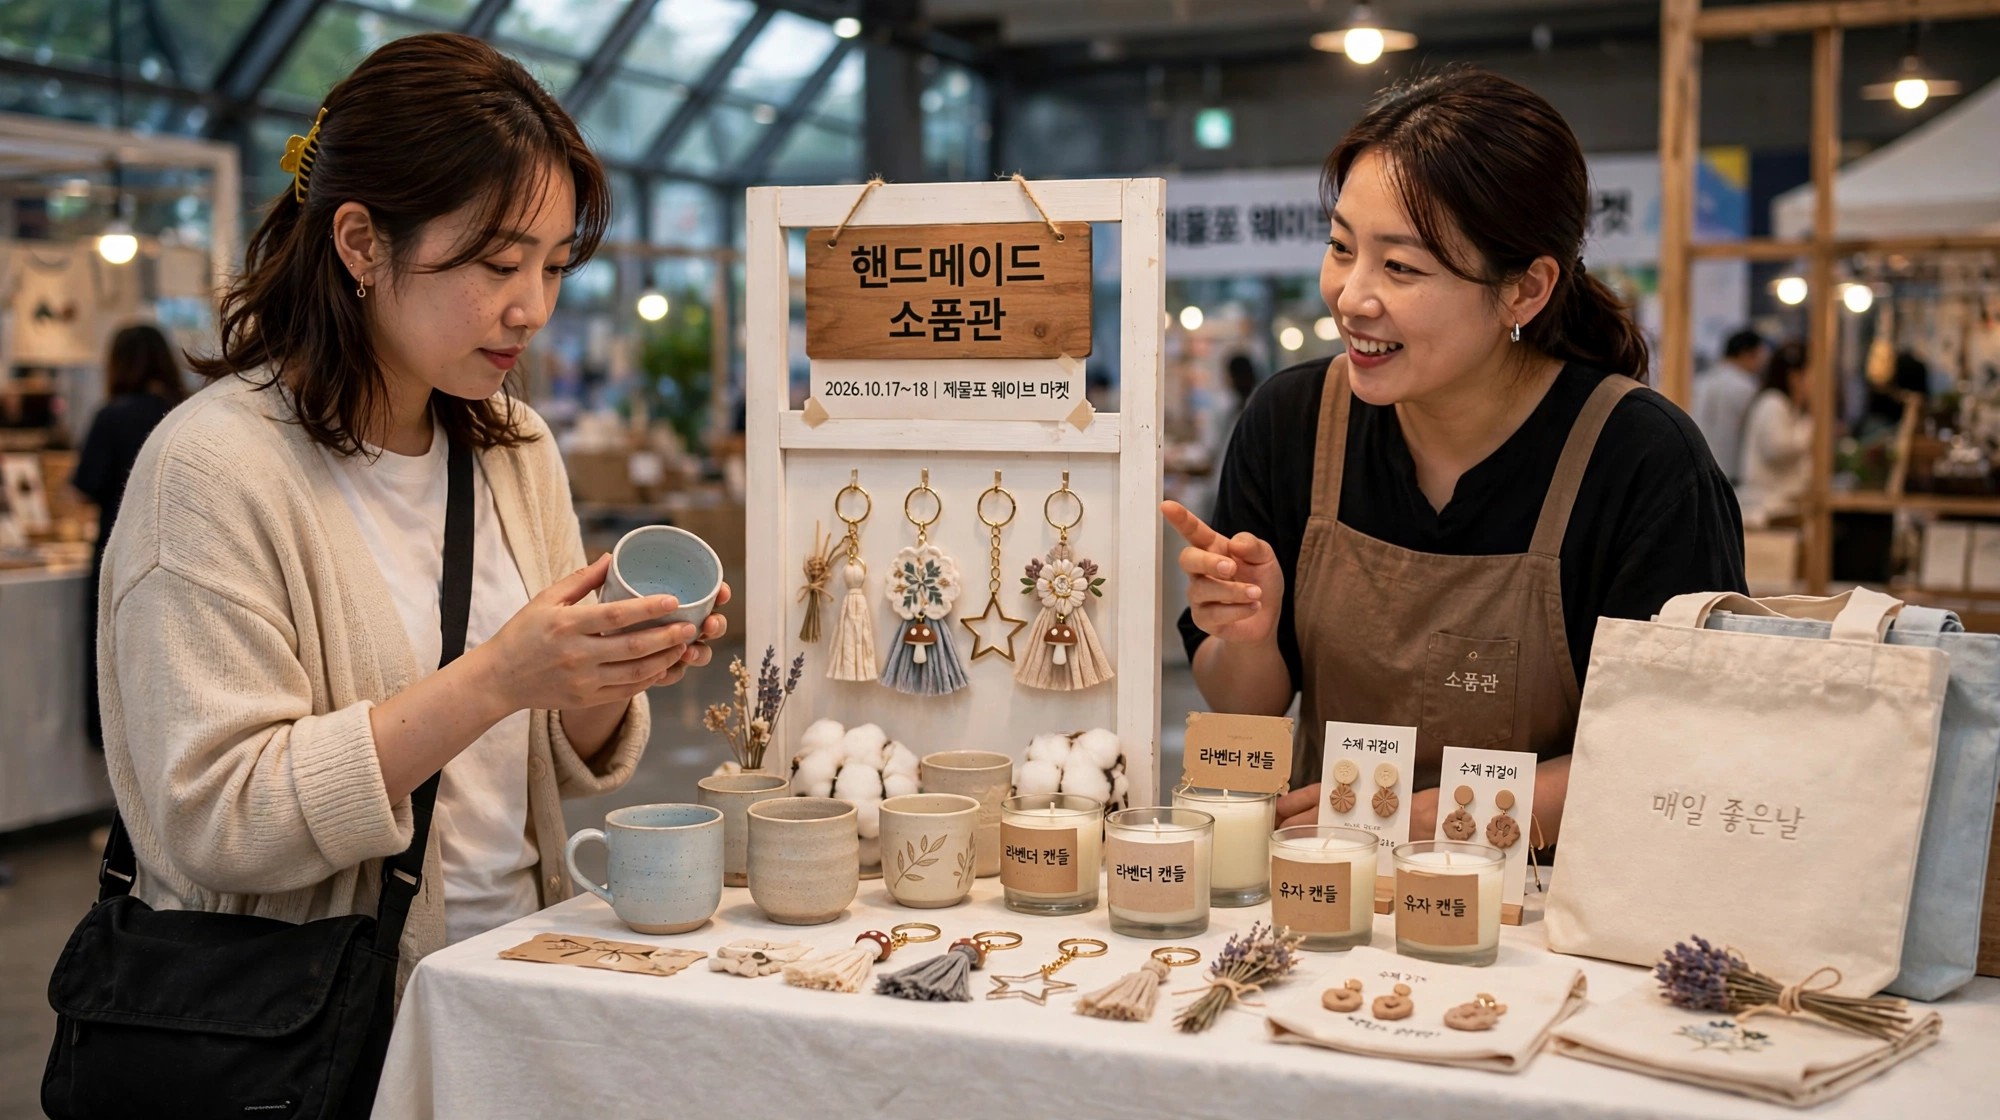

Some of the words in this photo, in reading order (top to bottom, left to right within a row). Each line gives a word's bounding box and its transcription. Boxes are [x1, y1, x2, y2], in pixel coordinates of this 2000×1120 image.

[851, 242, 1045, 289] 핸드메이드
[889, 297, 1007, 343] 소품관
[825, 381, 929, 397] 2026.10.17~18
[943, 380, 988, 399] 제물포
[991, 380, 1037, 399] 웨이브
[1040, 380, 1070, 400] 마켓
[1444, 671, 1499, 694] 소품관
[1341, 737, 1364, 751] 수제
[1366, 739, 1399, 754] 귀걸이
[1200, 747, 1242, 767] 라벤더
[1246, 750, 1276, 770] 캔들
[1459, 762, 1482, 776] 수제
[1484, 764, 1518, 780] 귀걸이
[1652, 790, 1706, 827] 매일
[1719, 798, 1806, 841] 좋은날
[1005, 844, 1038, 865] 라벤더
[1042, 848, 1070, 866] 캔들
[1116, 863, 1153, 883] 라벤더
[1157, 865, 1187, 883] 캔들
[1279, 881, 1305, 901] 유자
[1308, 884, 1338, 904] 캔들
[1403, 894, 1432, 915] 유자
[1435, 898, 1467, 918] 캔들
